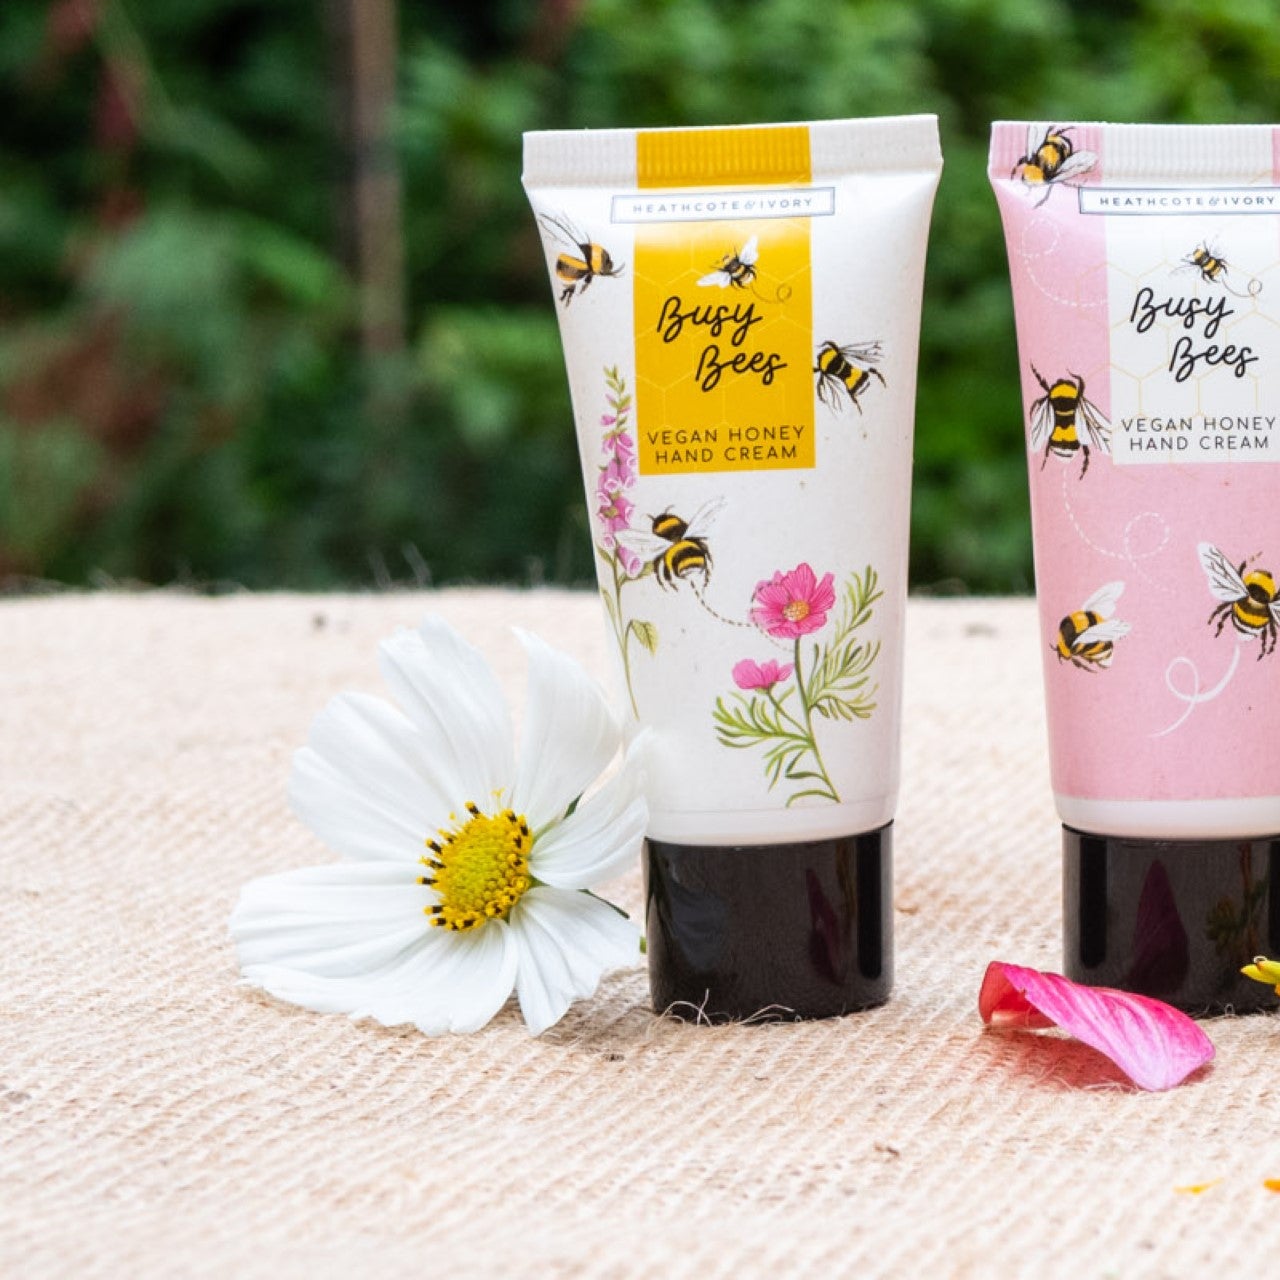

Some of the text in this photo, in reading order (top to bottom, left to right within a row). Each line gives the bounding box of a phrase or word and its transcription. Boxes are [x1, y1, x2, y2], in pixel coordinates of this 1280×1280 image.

[657, 296, 763, 346] Busy
[1130, 287, 1234, 339] Busy
[695, 345, 787, 392] Bees
[1168, 336, 1259, 382] Bees
[647, 425, 805, 445] VEGAN HONEY
[1121, 416, 1276, 432] VEGAN HONEY
[655, 445, 797, 464] HAND CREAM
[1130, 435, 1269, 451] HAND CREAM
